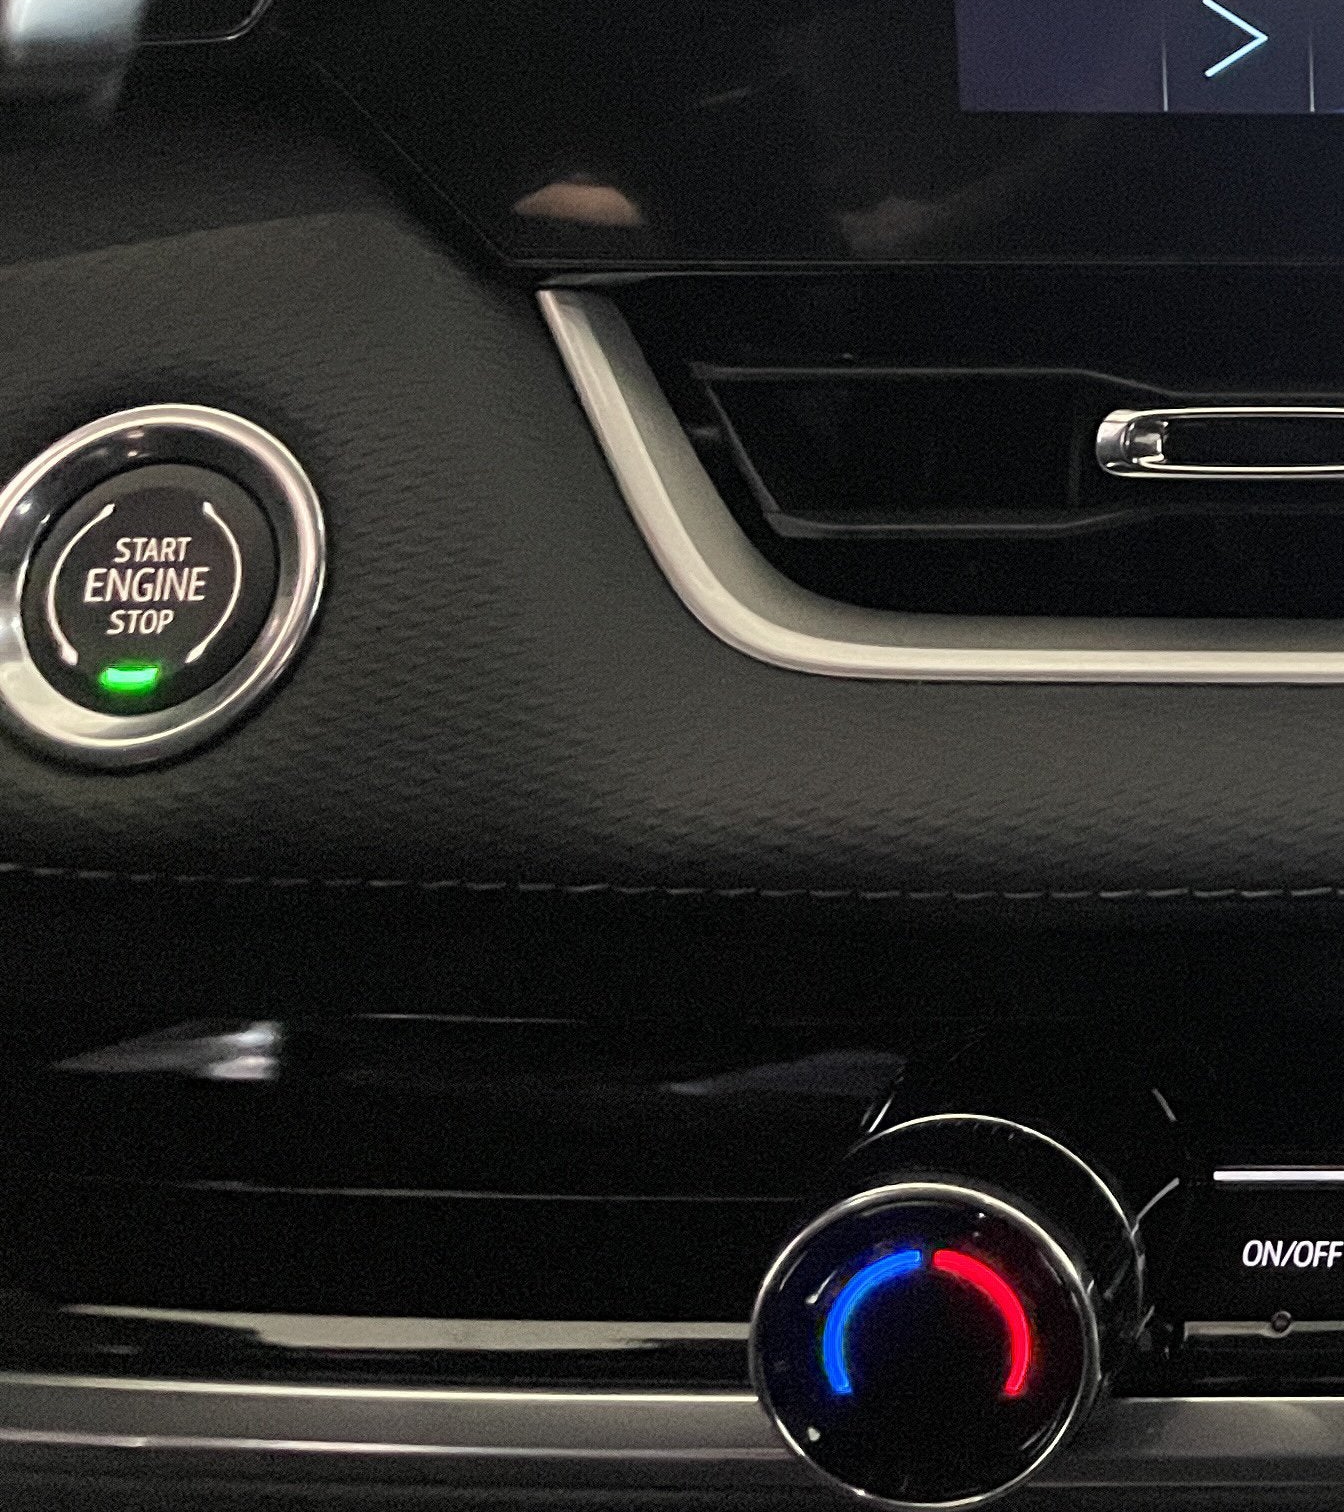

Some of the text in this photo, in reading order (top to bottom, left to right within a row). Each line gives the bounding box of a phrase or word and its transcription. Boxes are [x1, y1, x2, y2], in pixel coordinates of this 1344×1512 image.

[112, 536, 193, 564] START
[83, 566, 211, 604] ENGINE
[105, 609, 176, 636] STOP
[1241, 1239, 1344, 1268] ON/OFF
